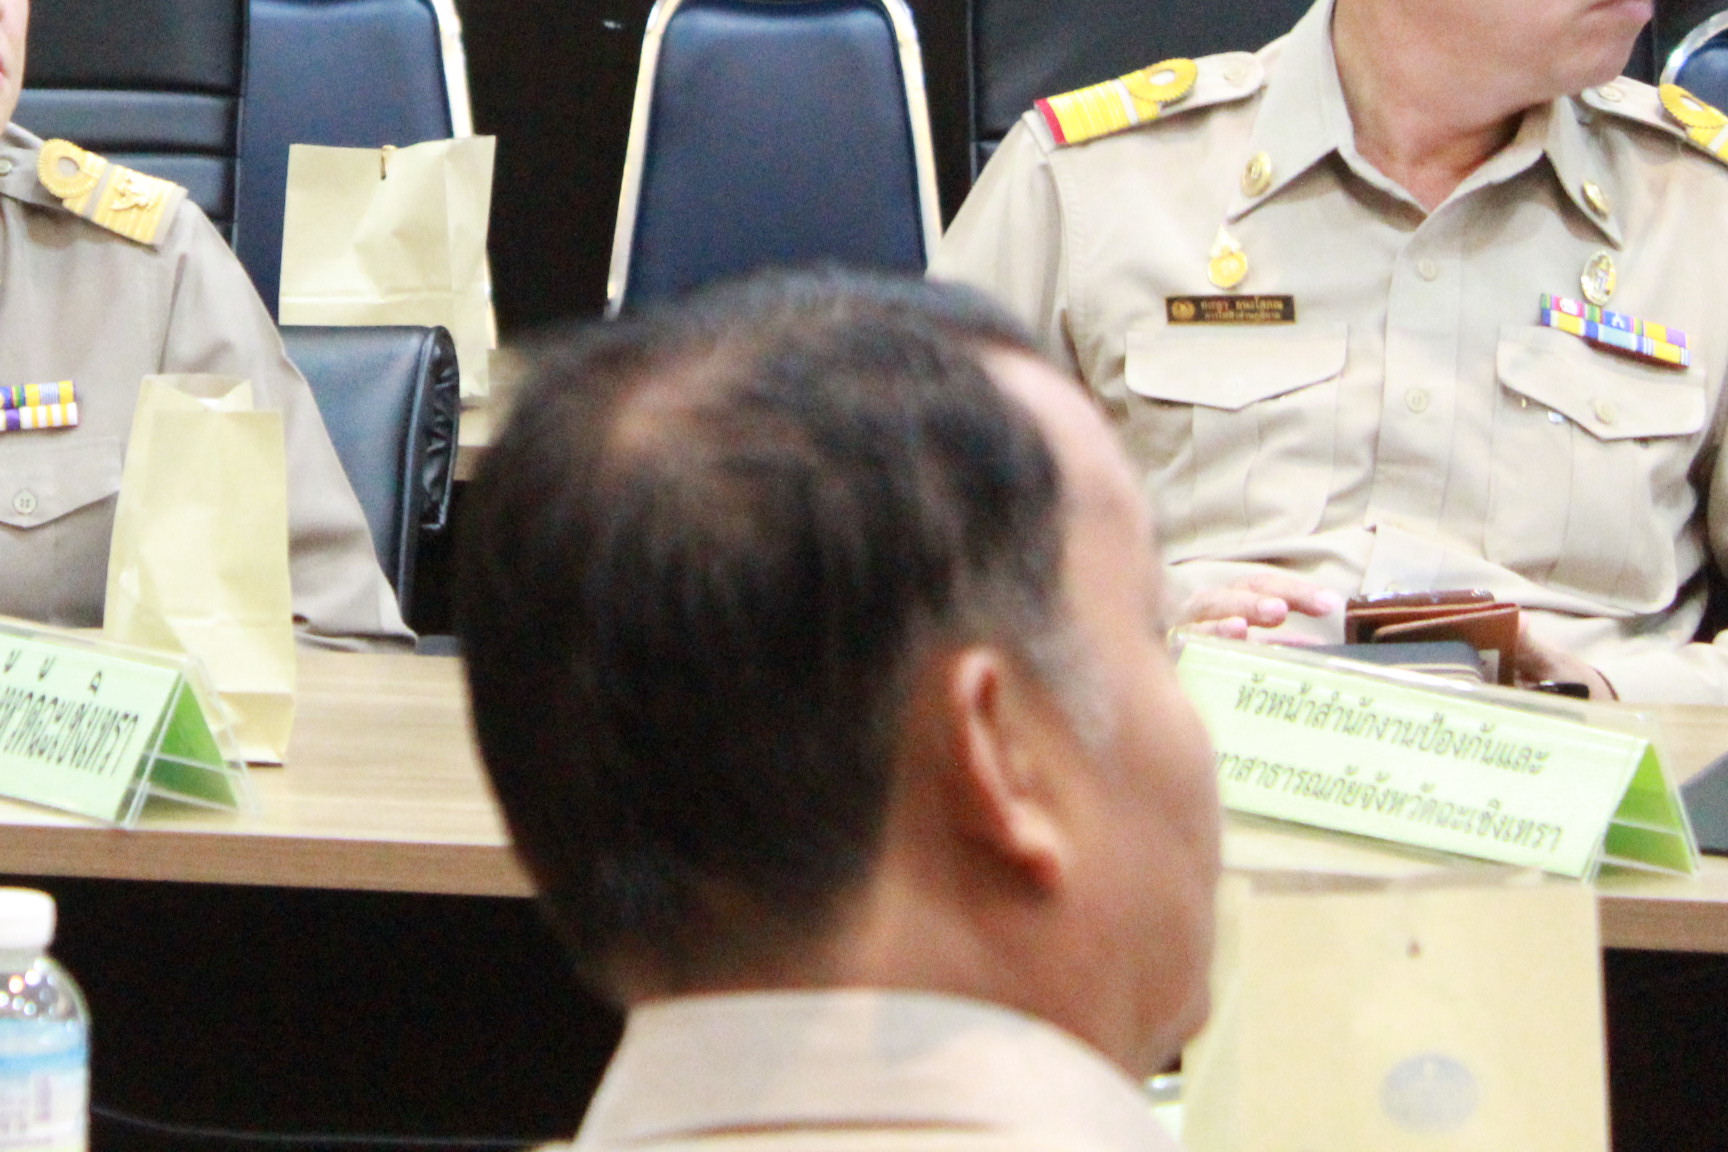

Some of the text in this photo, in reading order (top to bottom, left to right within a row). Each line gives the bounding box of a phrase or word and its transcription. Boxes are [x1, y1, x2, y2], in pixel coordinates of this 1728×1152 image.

[1234, 672, 1551, 775] หัวหน้าสำนักงานป้องกันและ
